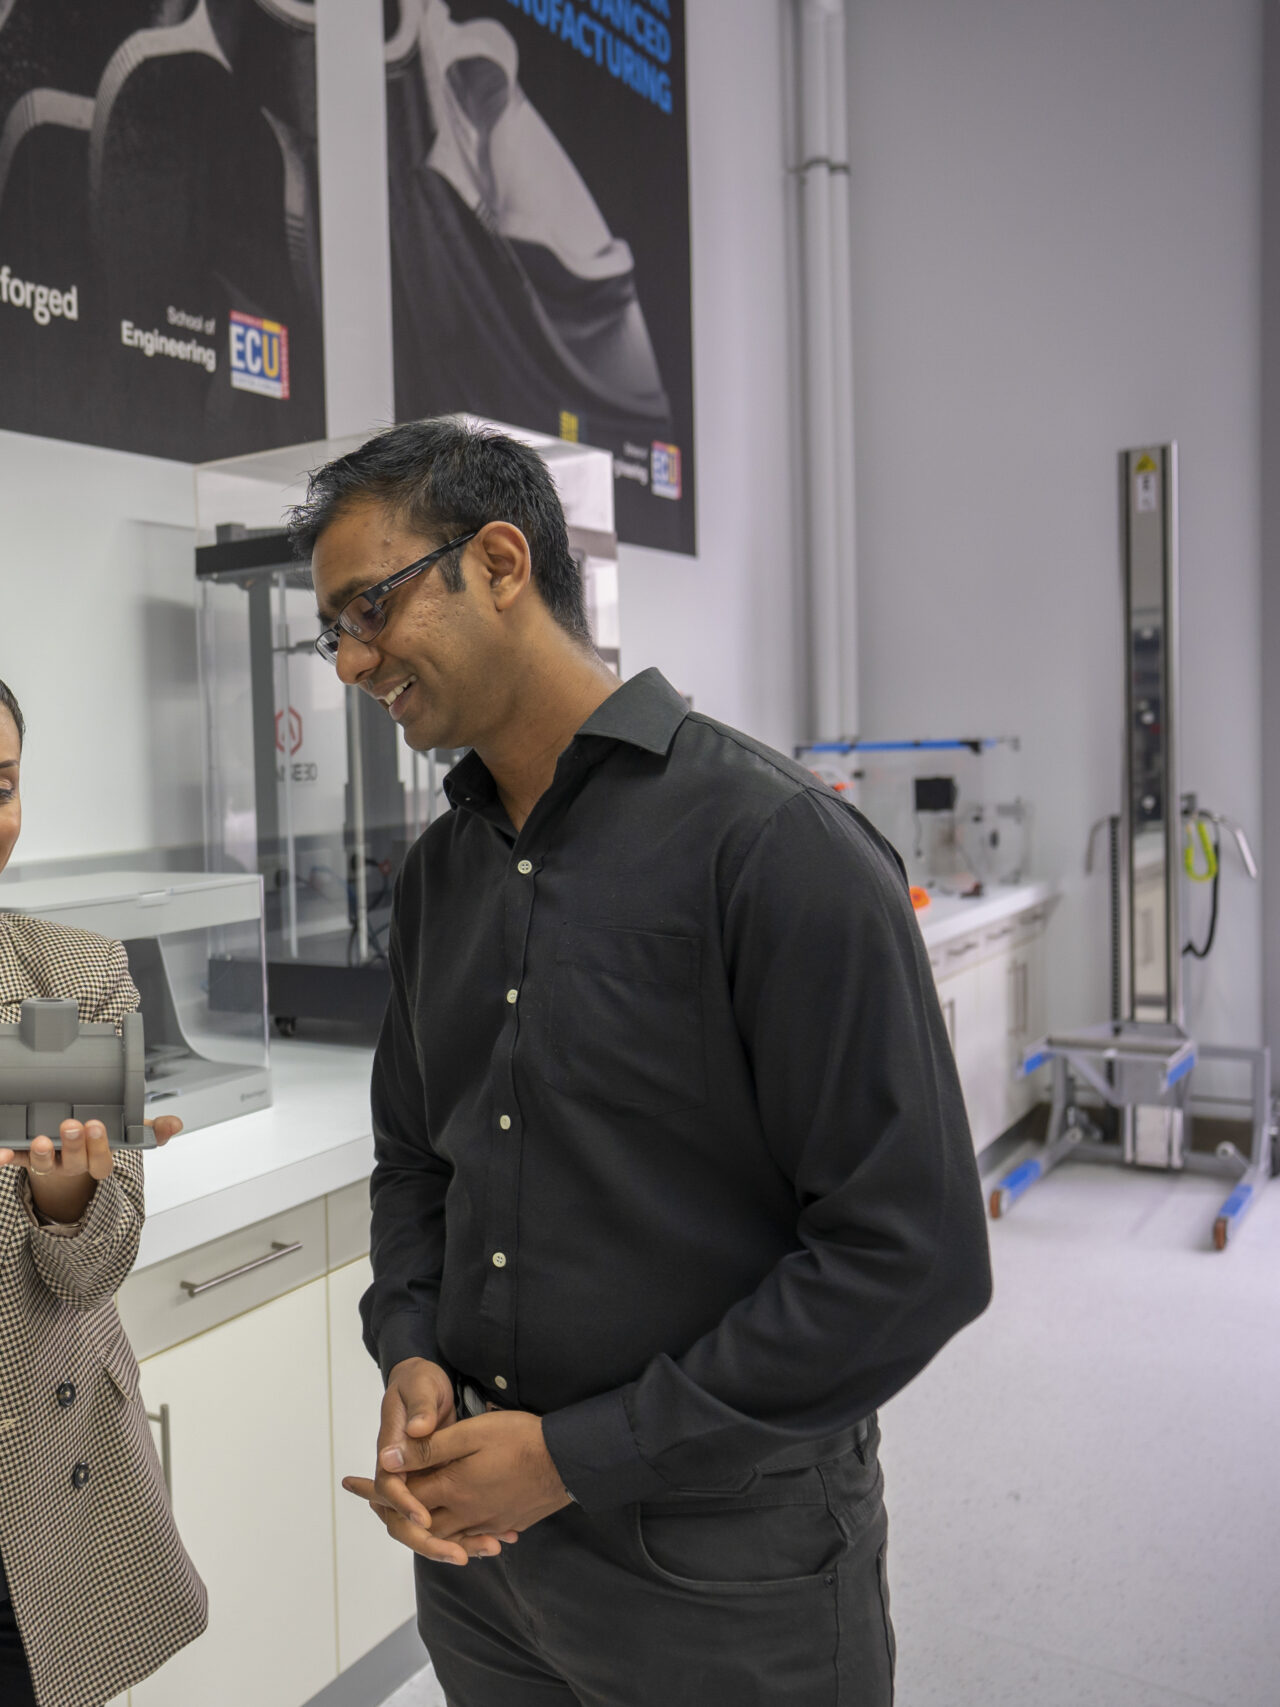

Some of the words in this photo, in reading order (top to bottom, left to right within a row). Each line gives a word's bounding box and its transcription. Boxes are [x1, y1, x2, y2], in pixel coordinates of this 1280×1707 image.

[121, 319, 217, 373] Engineering
[166, 305, 203, 332] School
[204, 318, 216, 336] of
[230, 322, 280, 379] ECU
